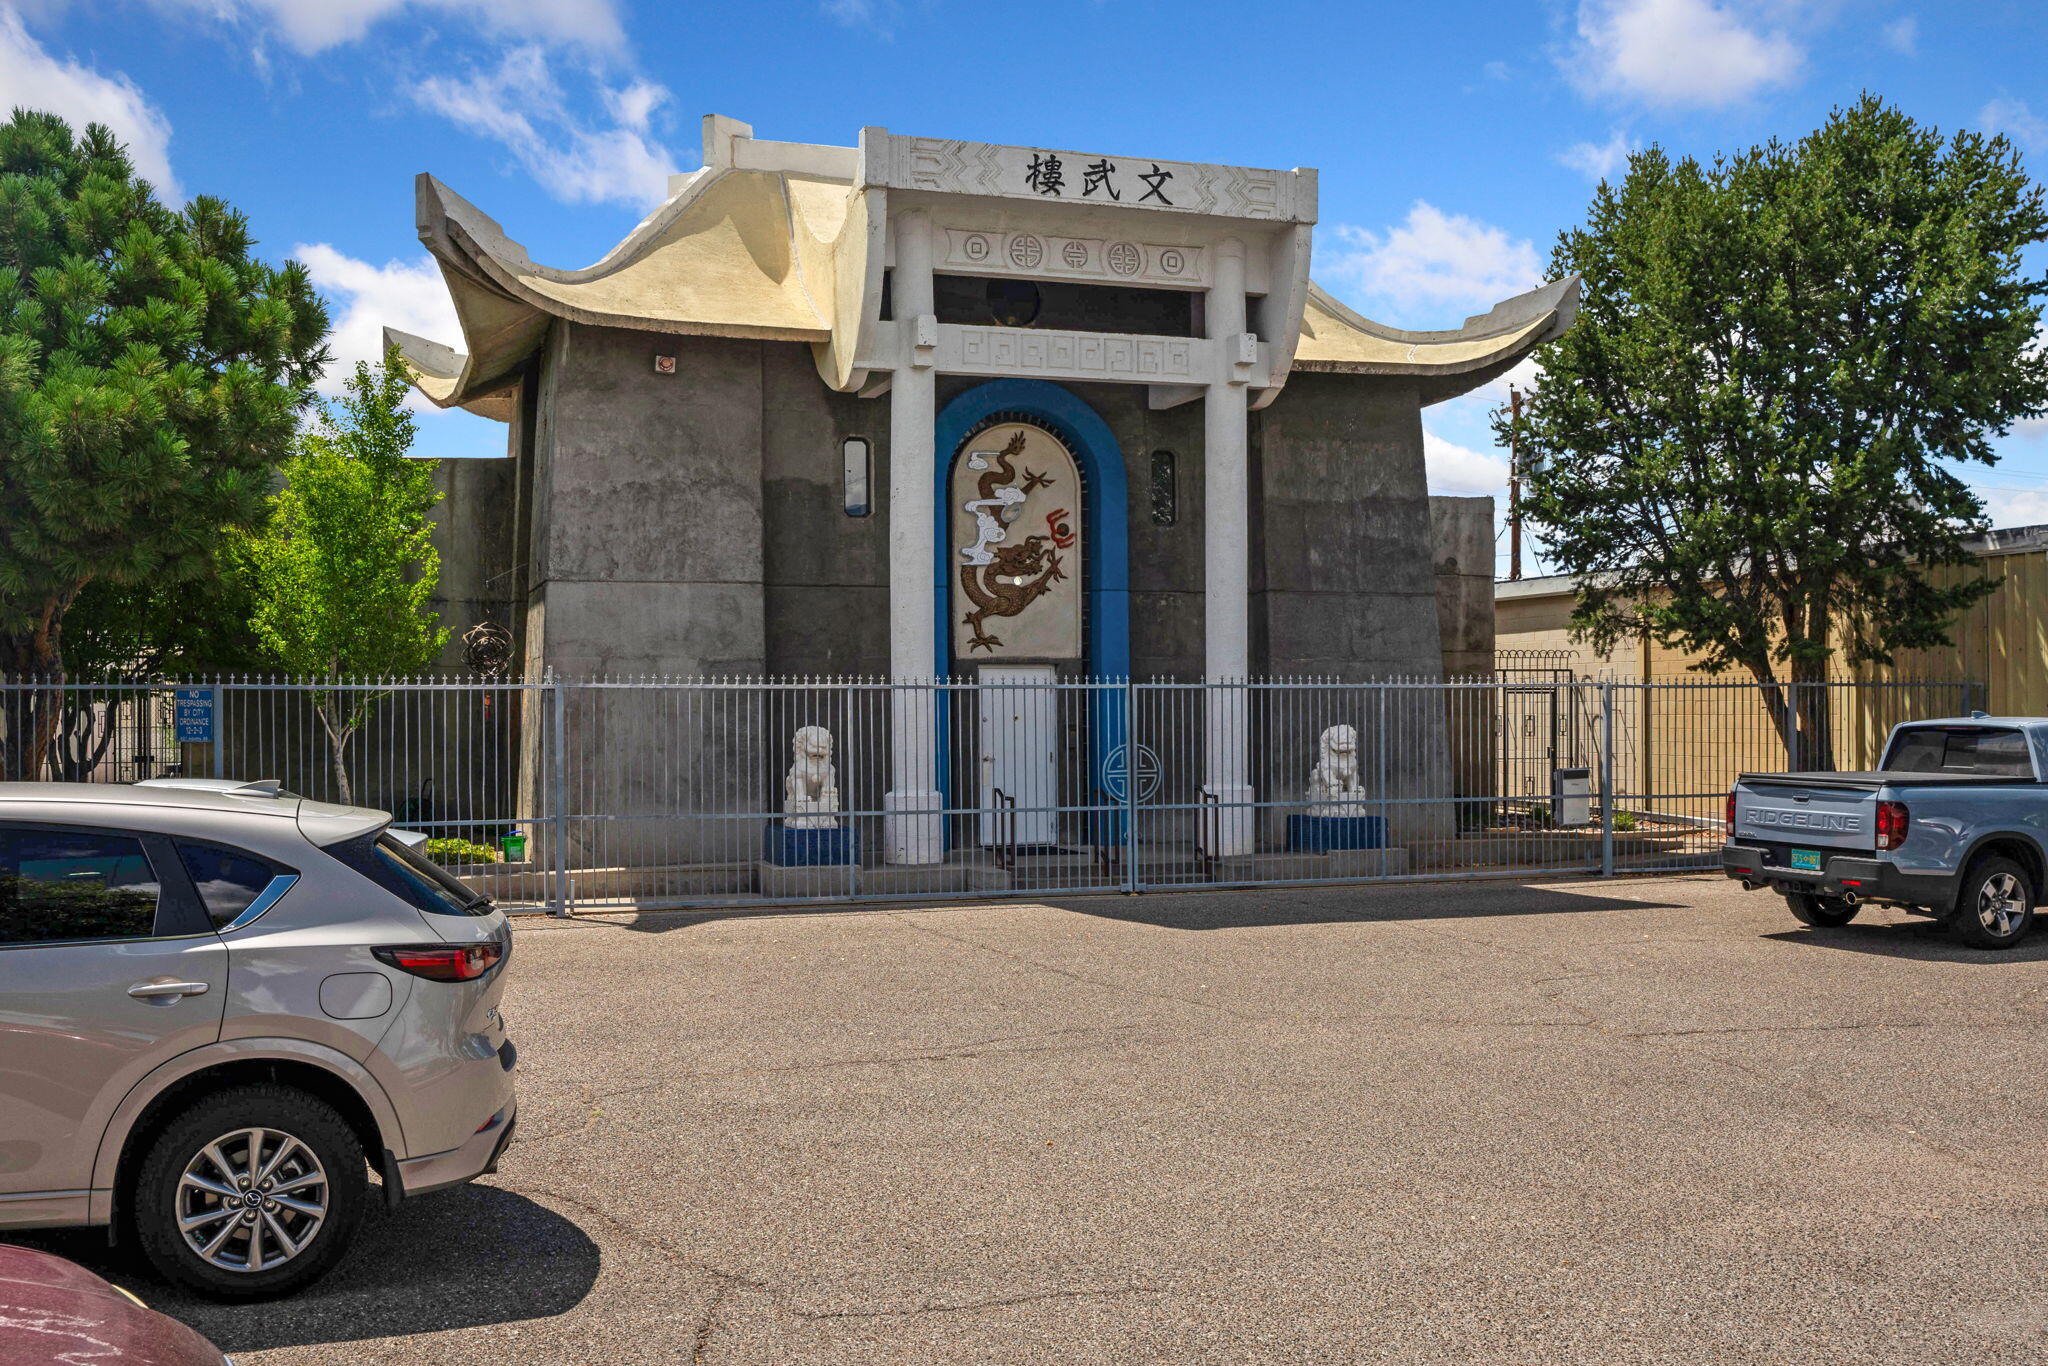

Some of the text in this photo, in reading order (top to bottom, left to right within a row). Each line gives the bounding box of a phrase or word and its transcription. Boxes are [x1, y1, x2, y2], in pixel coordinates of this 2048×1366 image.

[189, 690, 200, 699] NO
[177, 699, 212, 708] TRESPASSING
[184, 708, 204, 717] BY CITY
[179, 717, 209, 726] ORDINANCE
[1745, 808, 1861, 832] RIDGELINE
